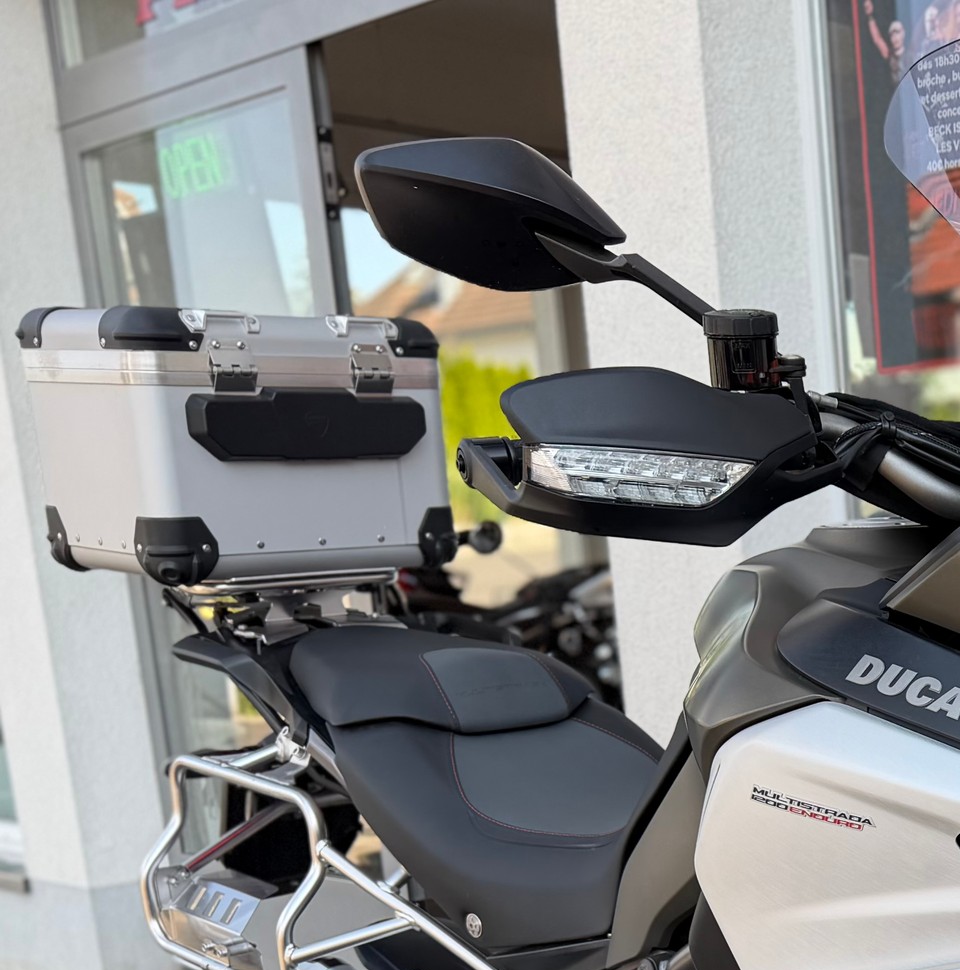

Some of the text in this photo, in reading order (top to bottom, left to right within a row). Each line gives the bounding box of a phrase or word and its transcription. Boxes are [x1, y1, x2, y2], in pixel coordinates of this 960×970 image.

[935, 53, 960, 68] 18h30
[928, 123, 951, 137] BECK
[936, 140, 952, 154] LES
[160, 134, 224, 198] OPEN
[752, 785, 875, 827] MULTISTRADA
